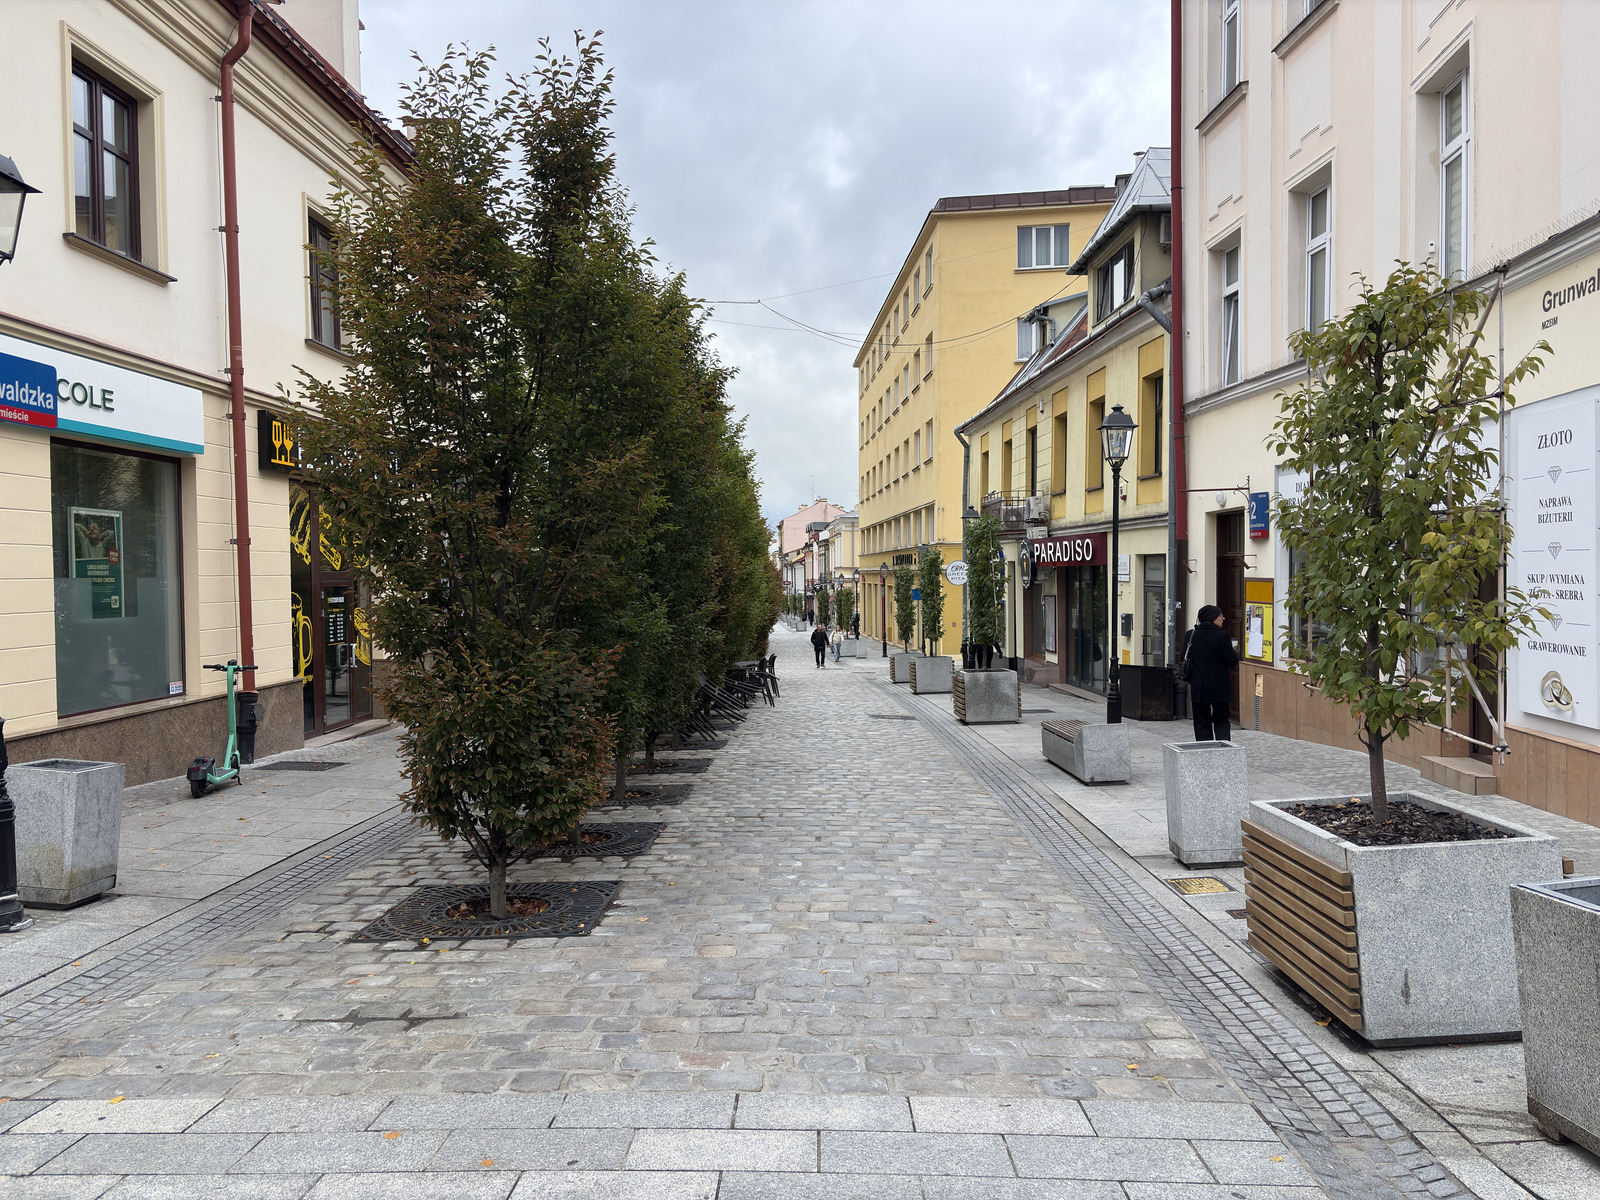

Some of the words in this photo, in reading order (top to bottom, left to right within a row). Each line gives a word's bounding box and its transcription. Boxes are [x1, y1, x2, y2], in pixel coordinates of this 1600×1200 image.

[1542, 268, 1600, 313] Grunwal
[1537, 428, 1573, 450] ZŁOTO
[1250, 501, 1256, 520] 2
[1538, 495, 1572, 509] NAPRAWA
[1537, 511, 1573, 524] BIŻUTERII
[1033, 538, 1093, 562] PARADISO
[1527, 573, 1545, 584] SKUP
[1549, 574, 1584, 584] WYMIANA
[1555, 589, 1584, 601] SREBRA
[1527, 640, 1586, 657] GRAWEROWANIE
